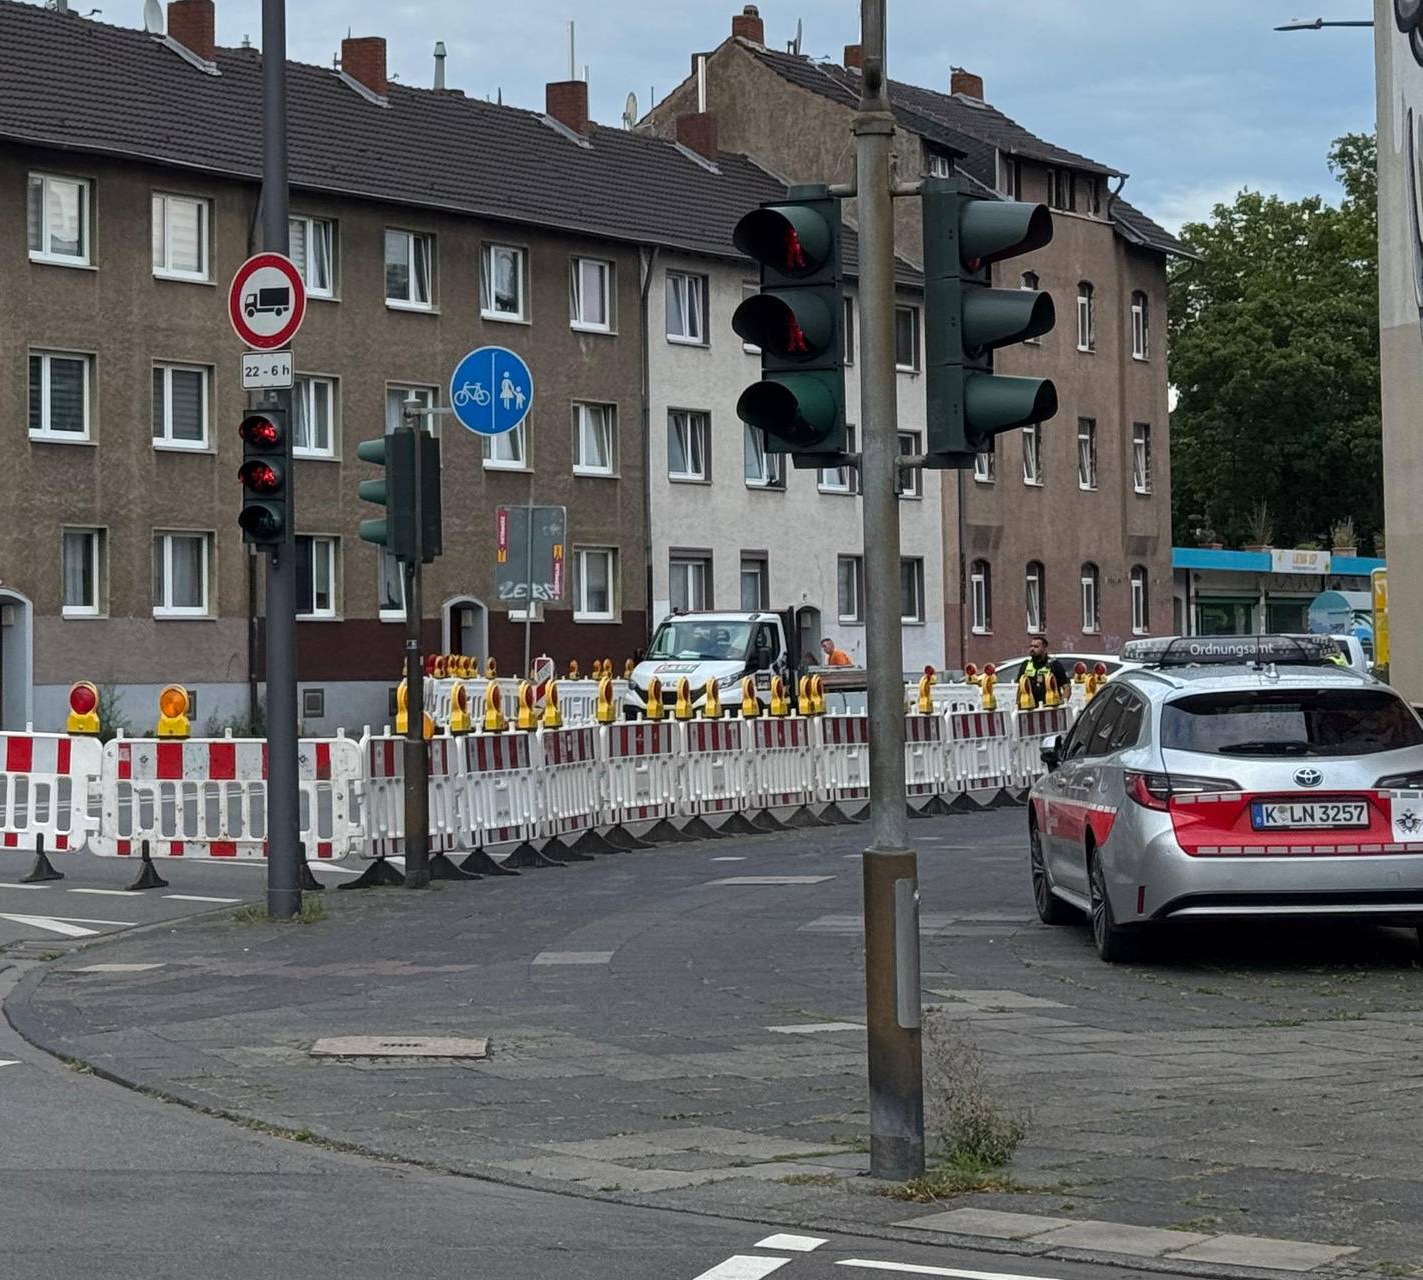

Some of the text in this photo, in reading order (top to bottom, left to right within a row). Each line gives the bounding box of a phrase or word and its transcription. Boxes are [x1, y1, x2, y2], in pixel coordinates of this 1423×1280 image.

[245, 366, 260, 378] 22
[271, 365, 279, 376] 6
[282, 364, 290, 376] h
[1189, 641, 1275, 658] Ordnungsamt
[1265, 804, 1365, 824] K LN 3257
